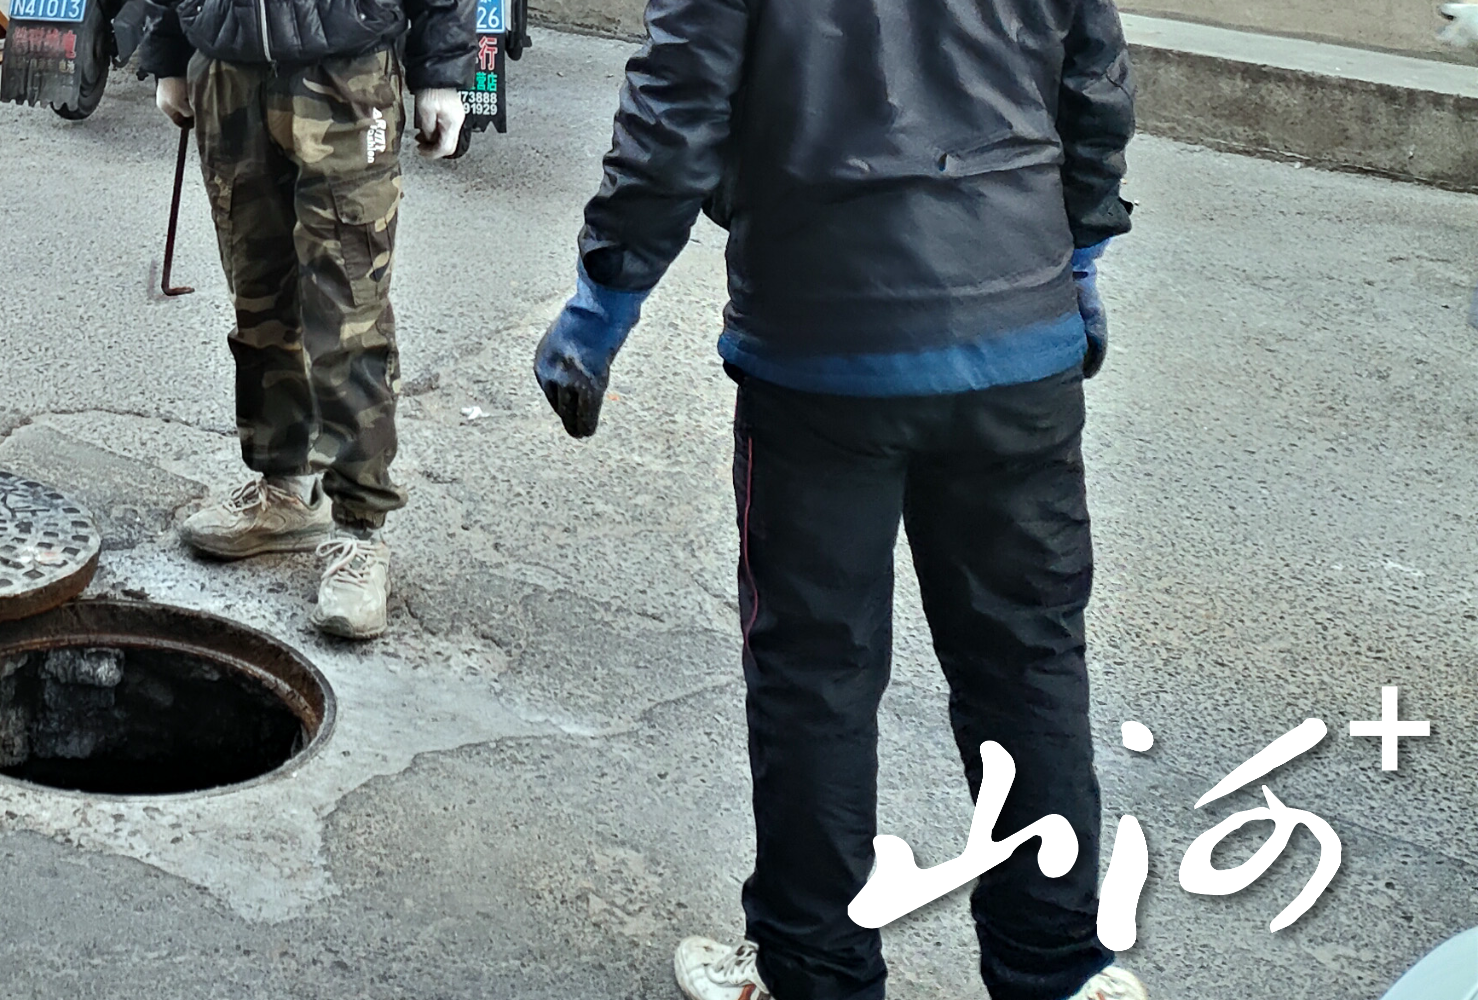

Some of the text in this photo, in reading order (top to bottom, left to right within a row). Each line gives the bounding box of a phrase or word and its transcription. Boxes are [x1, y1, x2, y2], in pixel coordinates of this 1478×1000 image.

[476, 6, 500, 29] 26
[476, 36, 498, 71] 行
[471, 71, 498, 92] 营店
